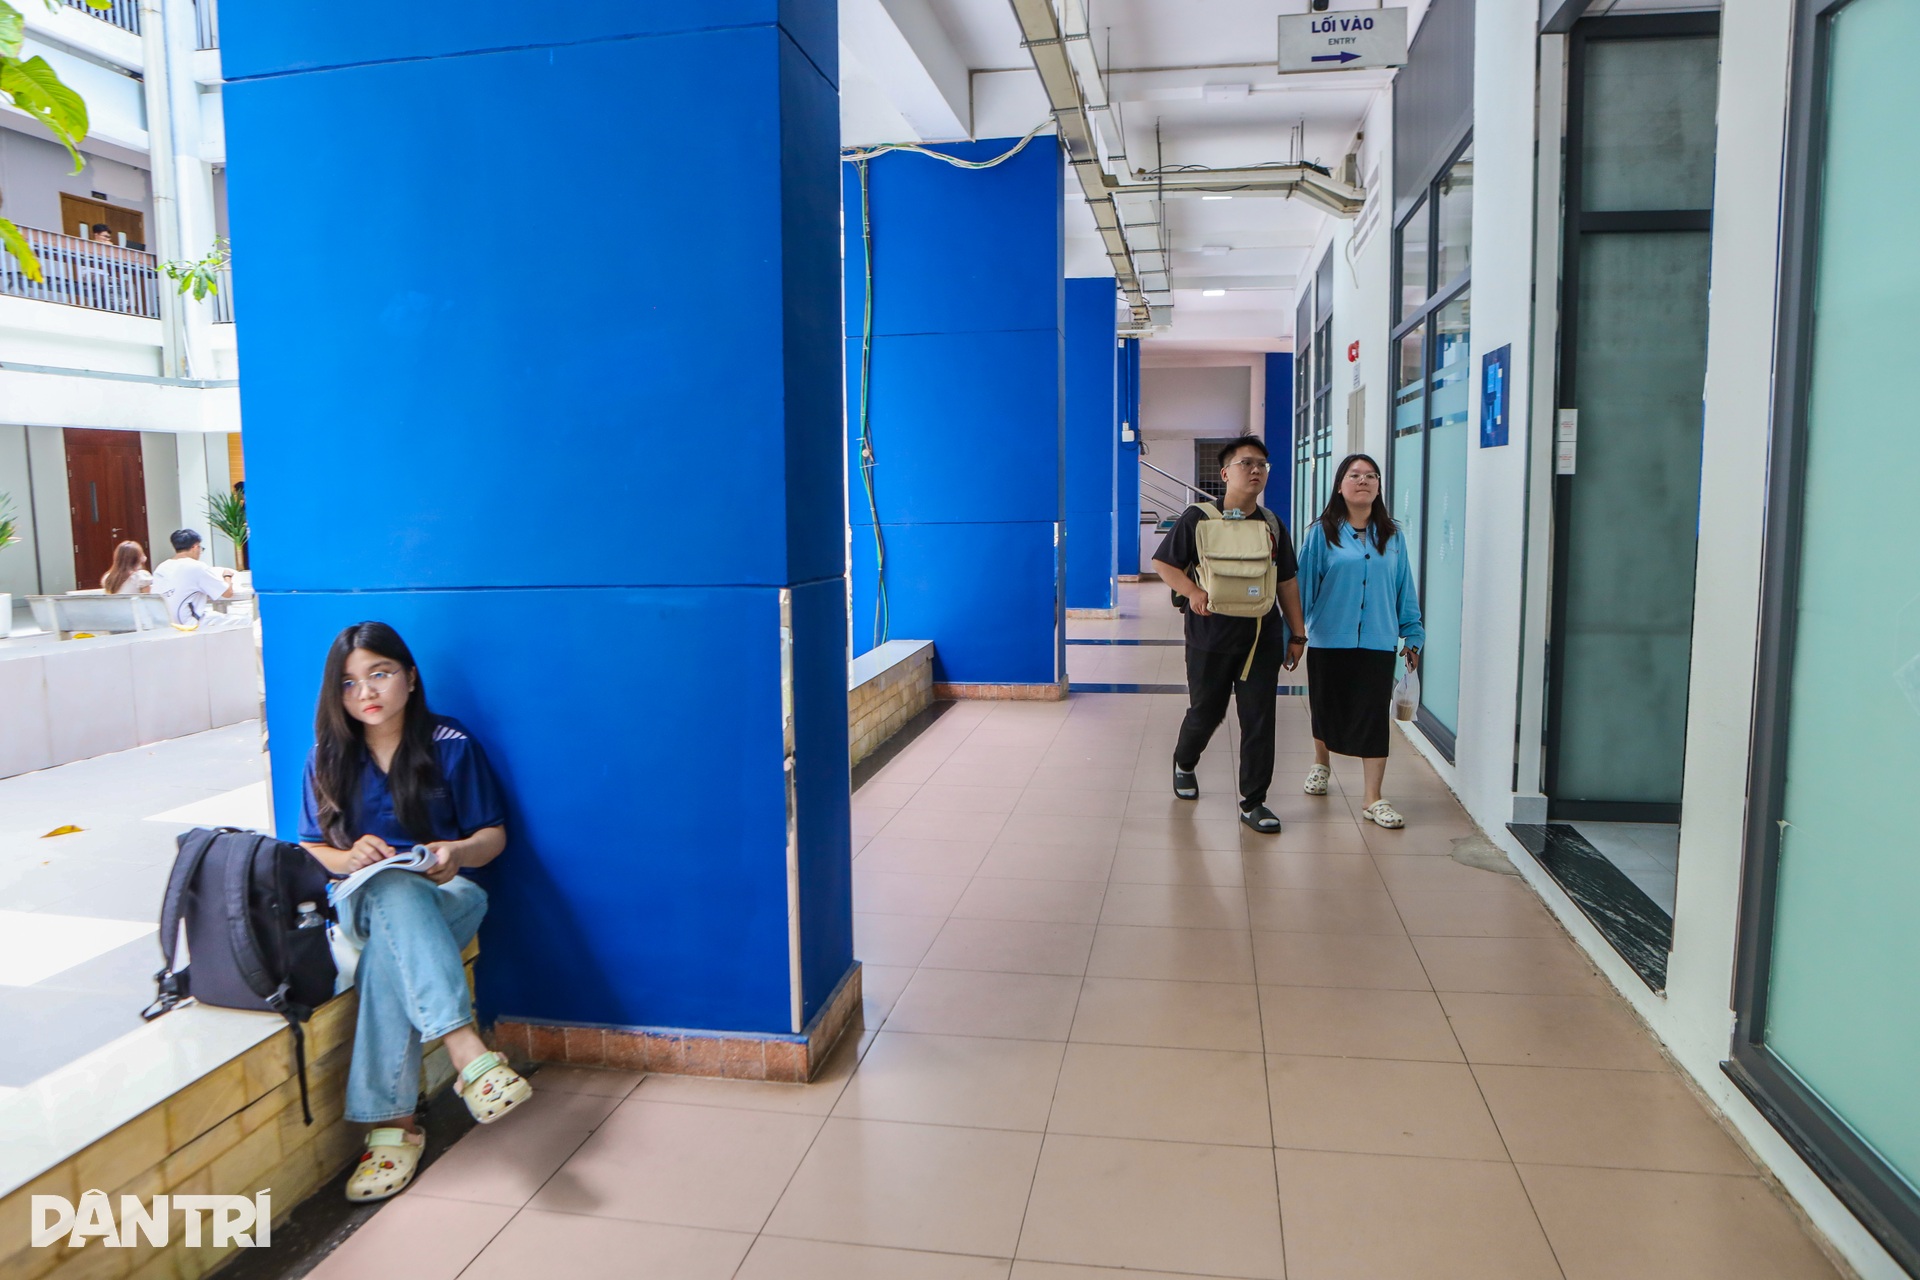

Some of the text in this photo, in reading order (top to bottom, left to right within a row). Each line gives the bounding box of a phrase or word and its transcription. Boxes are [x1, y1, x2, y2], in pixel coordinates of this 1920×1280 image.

[1311, 16, 1374, 33] LỐI VÀO
[1328, 37, 1357, 46] ENTRY
